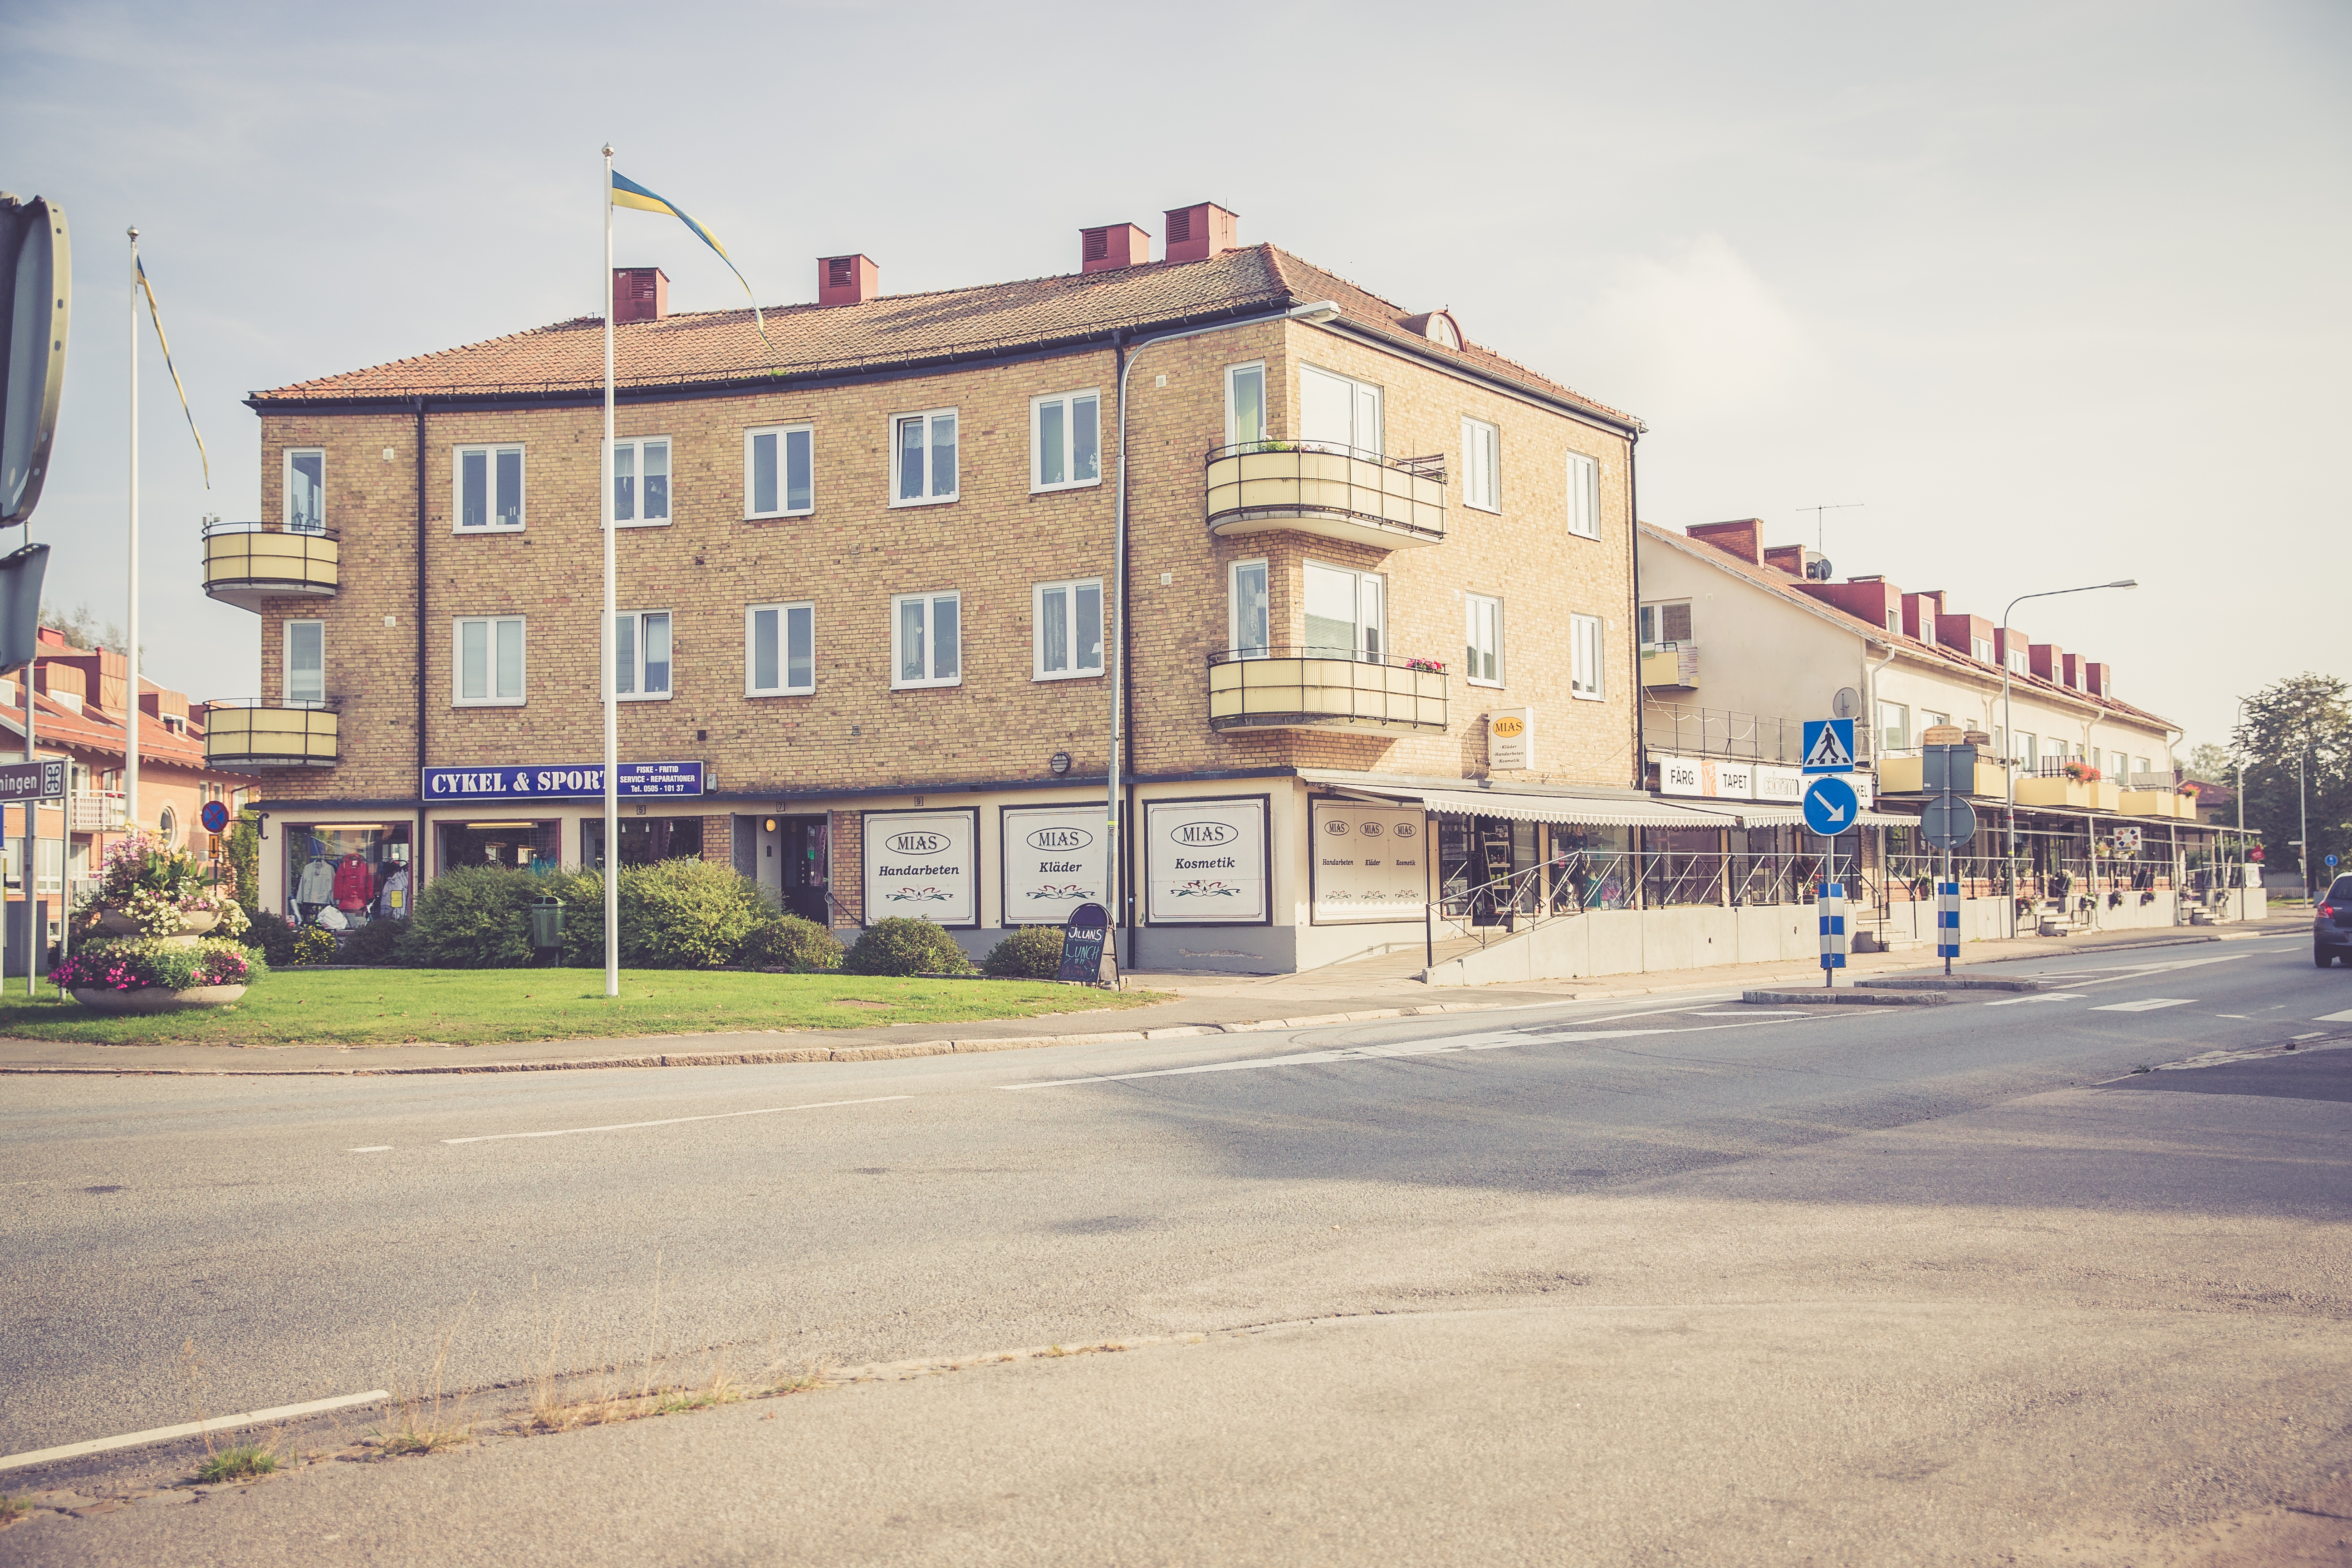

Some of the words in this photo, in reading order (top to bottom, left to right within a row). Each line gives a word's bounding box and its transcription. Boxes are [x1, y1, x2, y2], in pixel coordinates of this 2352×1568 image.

[1495, 722, 1522, 732] MIAS
[432, 773, 506, 793] CYKEL
[513, 772, 530, 791] &
[1671, 766, 1694, 785] FÄRG
[1723, 774, 1747, 789] TAPET
[1853, 784, 1867, 797] KEL
[1182, 826, 1224, 842] MIAS
[1329, 823, 1345, 833] MIAS
[1364, 825, 1380, 834] MIAS
[1397, 826, 1412, 835] MIAS
[897, 836, 938, 850] MIAS
[1039, 832, 1080, 847] MIAS
[1039, 862, 1082, 872] Kläder
[1175, 857, 1235, 869] Kosmetik
[879, 865, 960, 876] Handarbeten
[1068, 927, 1102, 941] JILLANS
[1065, 943, 1100, 960] LUNCH
